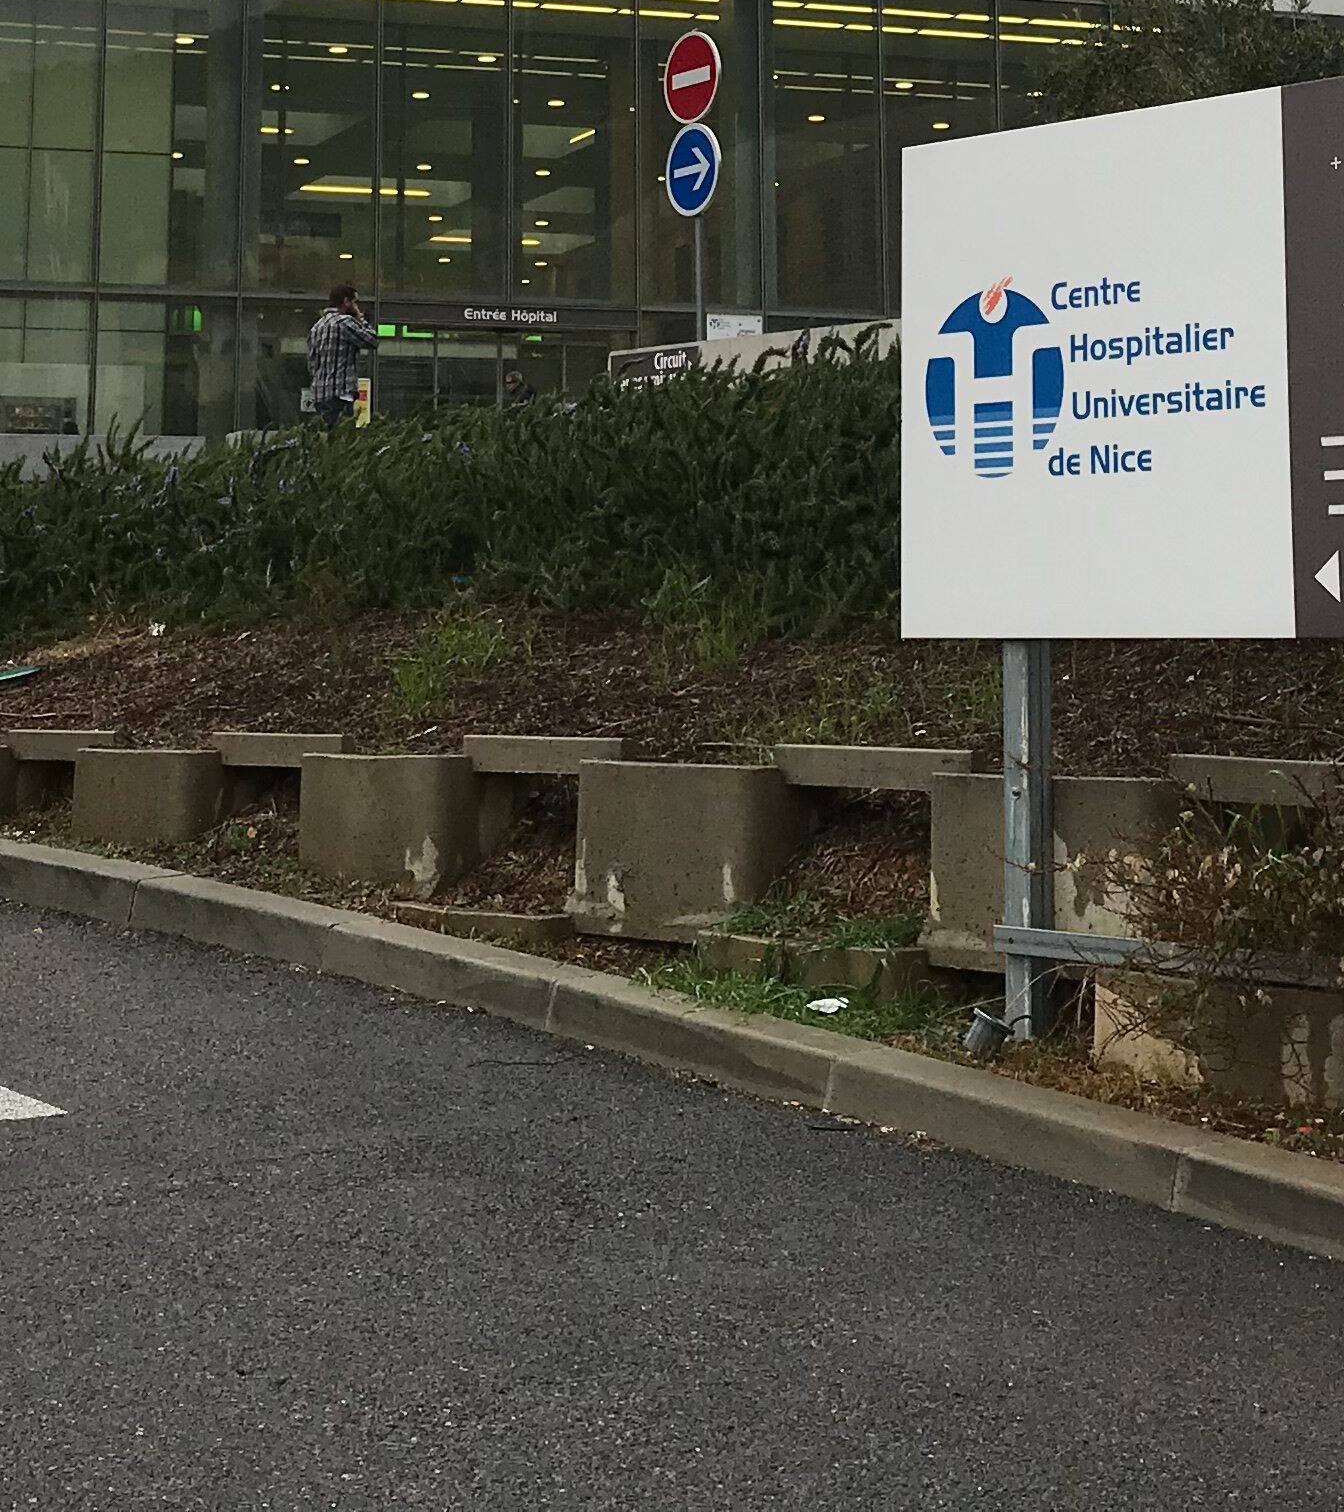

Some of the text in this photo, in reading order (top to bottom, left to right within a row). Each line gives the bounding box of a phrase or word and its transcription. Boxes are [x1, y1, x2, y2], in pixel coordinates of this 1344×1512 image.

[1050, 277, 1141, 311] Centre
[463, 308, 557, 324] Entrée Hôpital
[654, 350, 687, 371] Circuit
[1070, 323, 1235, 366] Hospitalier
[1072, 379, 1266, 420] Universitaire
[1048, 443, 1152, 477] de Nice
